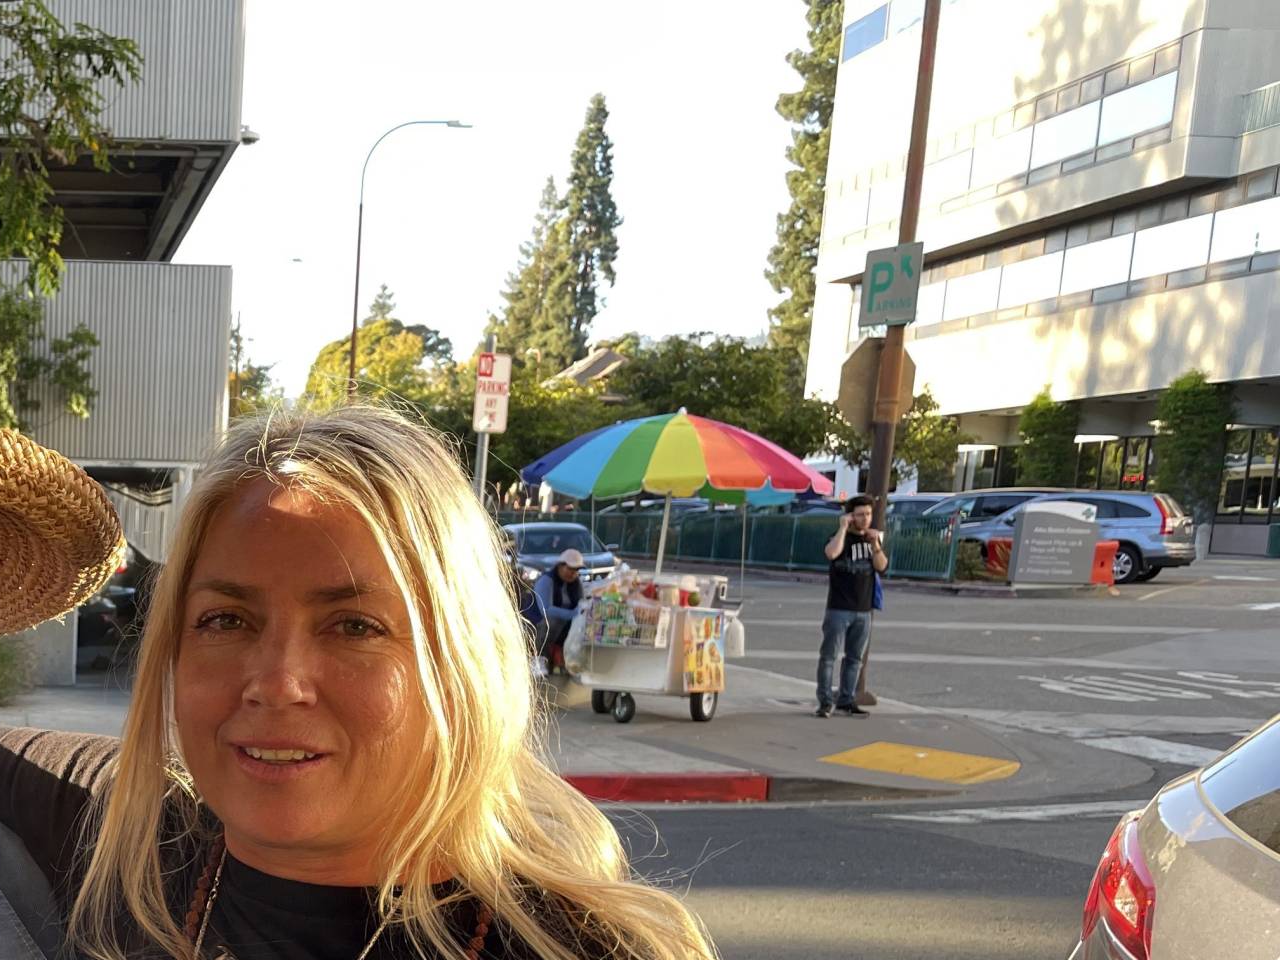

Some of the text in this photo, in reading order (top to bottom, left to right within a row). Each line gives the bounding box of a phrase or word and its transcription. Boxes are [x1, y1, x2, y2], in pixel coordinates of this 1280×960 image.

[480, 356, 492, 374] NO
[479, 381, 507, 395] PARKING
[486, 398, 497, 408] ANY
